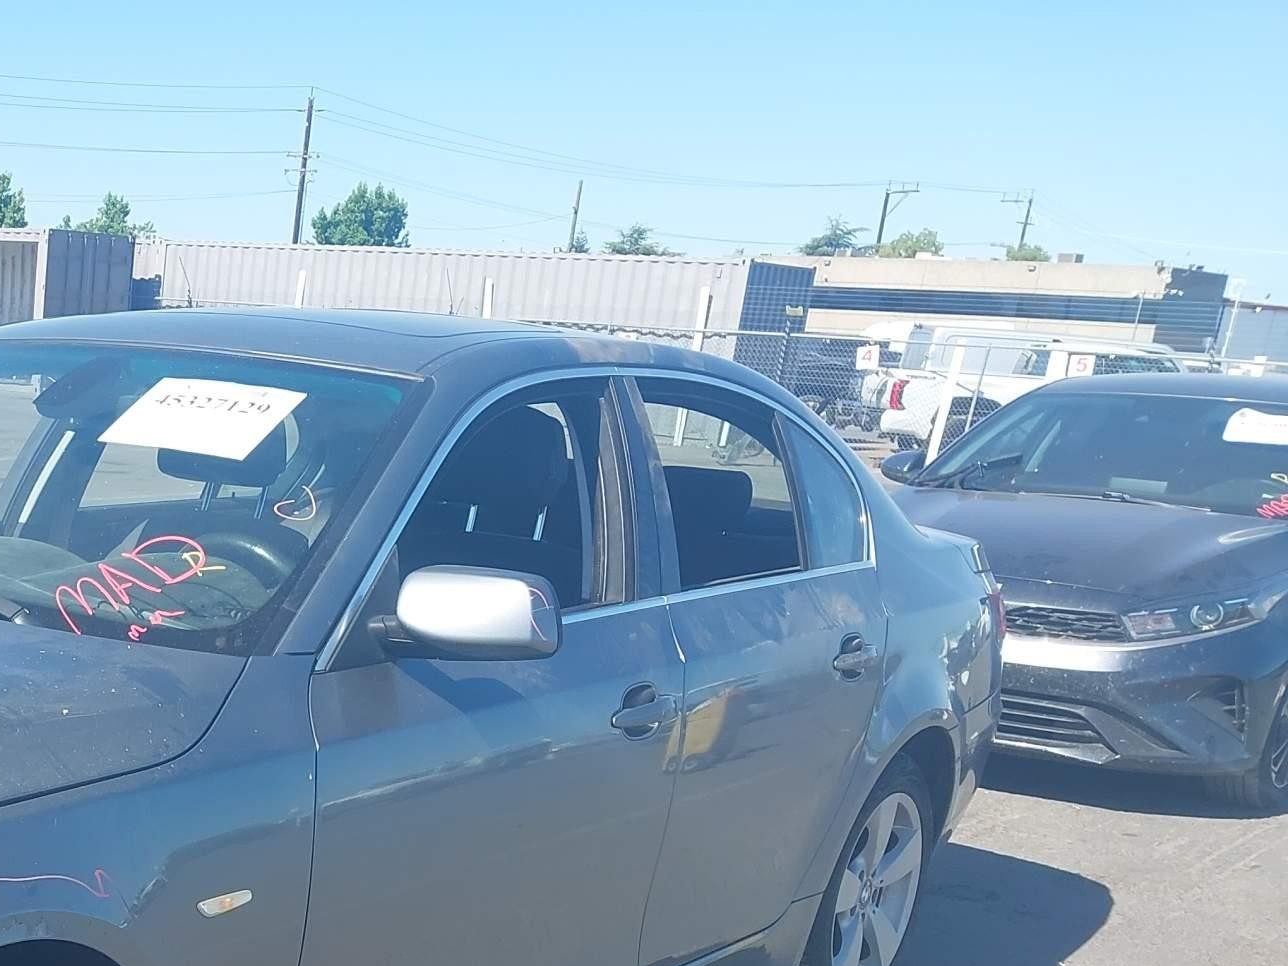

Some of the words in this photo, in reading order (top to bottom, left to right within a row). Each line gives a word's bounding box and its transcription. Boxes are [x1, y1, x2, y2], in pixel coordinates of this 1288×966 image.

[861, 349, 873, 362] 4
[1076, 357, 1088, 372] 5
[155, 394, 271, 414] 45327129
